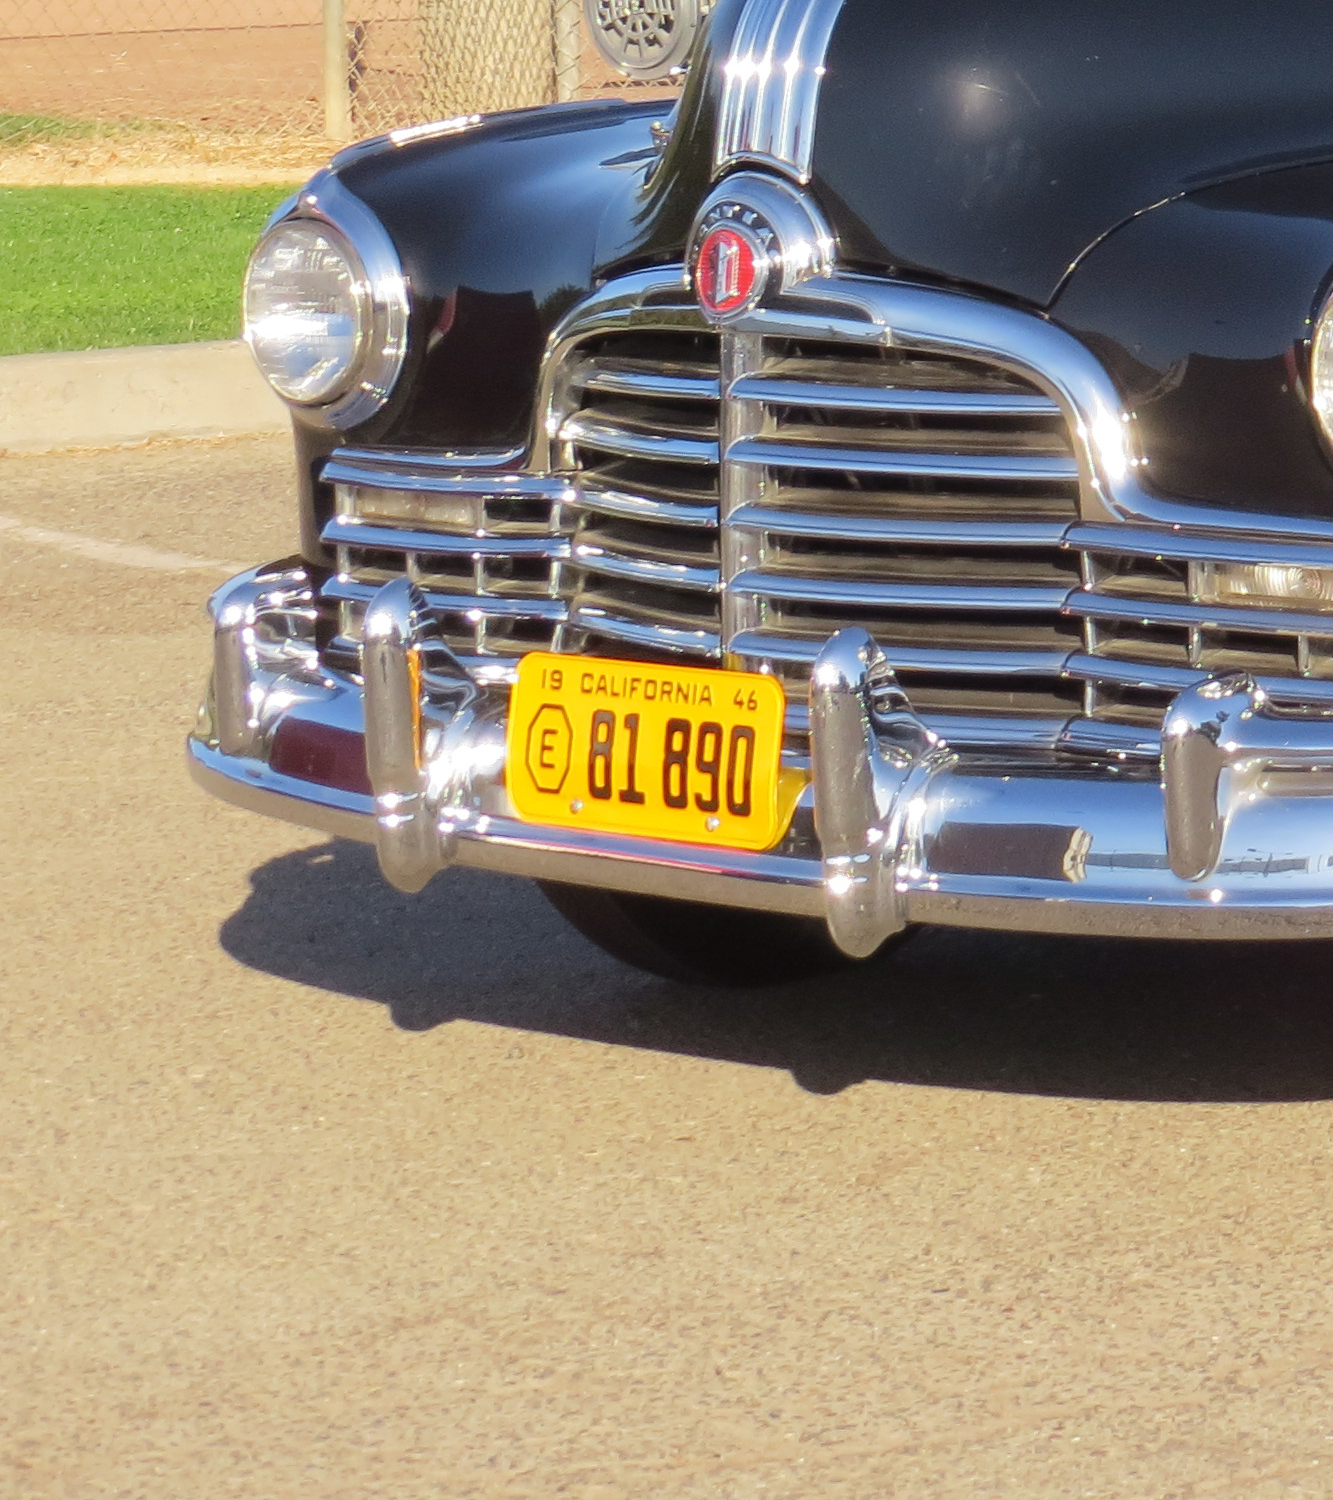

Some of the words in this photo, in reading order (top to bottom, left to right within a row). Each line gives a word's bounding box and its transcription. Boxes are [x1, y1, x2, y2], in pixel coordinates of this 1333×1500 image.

[540, 667, 564, 691] 19
[580, 672, 715, 707] CALIFORNIA
[733, 688, 759, 712] 46
[538, 728, 560, 769] E
[587, 708, 646, 805] 81
[662, 717, 757, 817] 890
